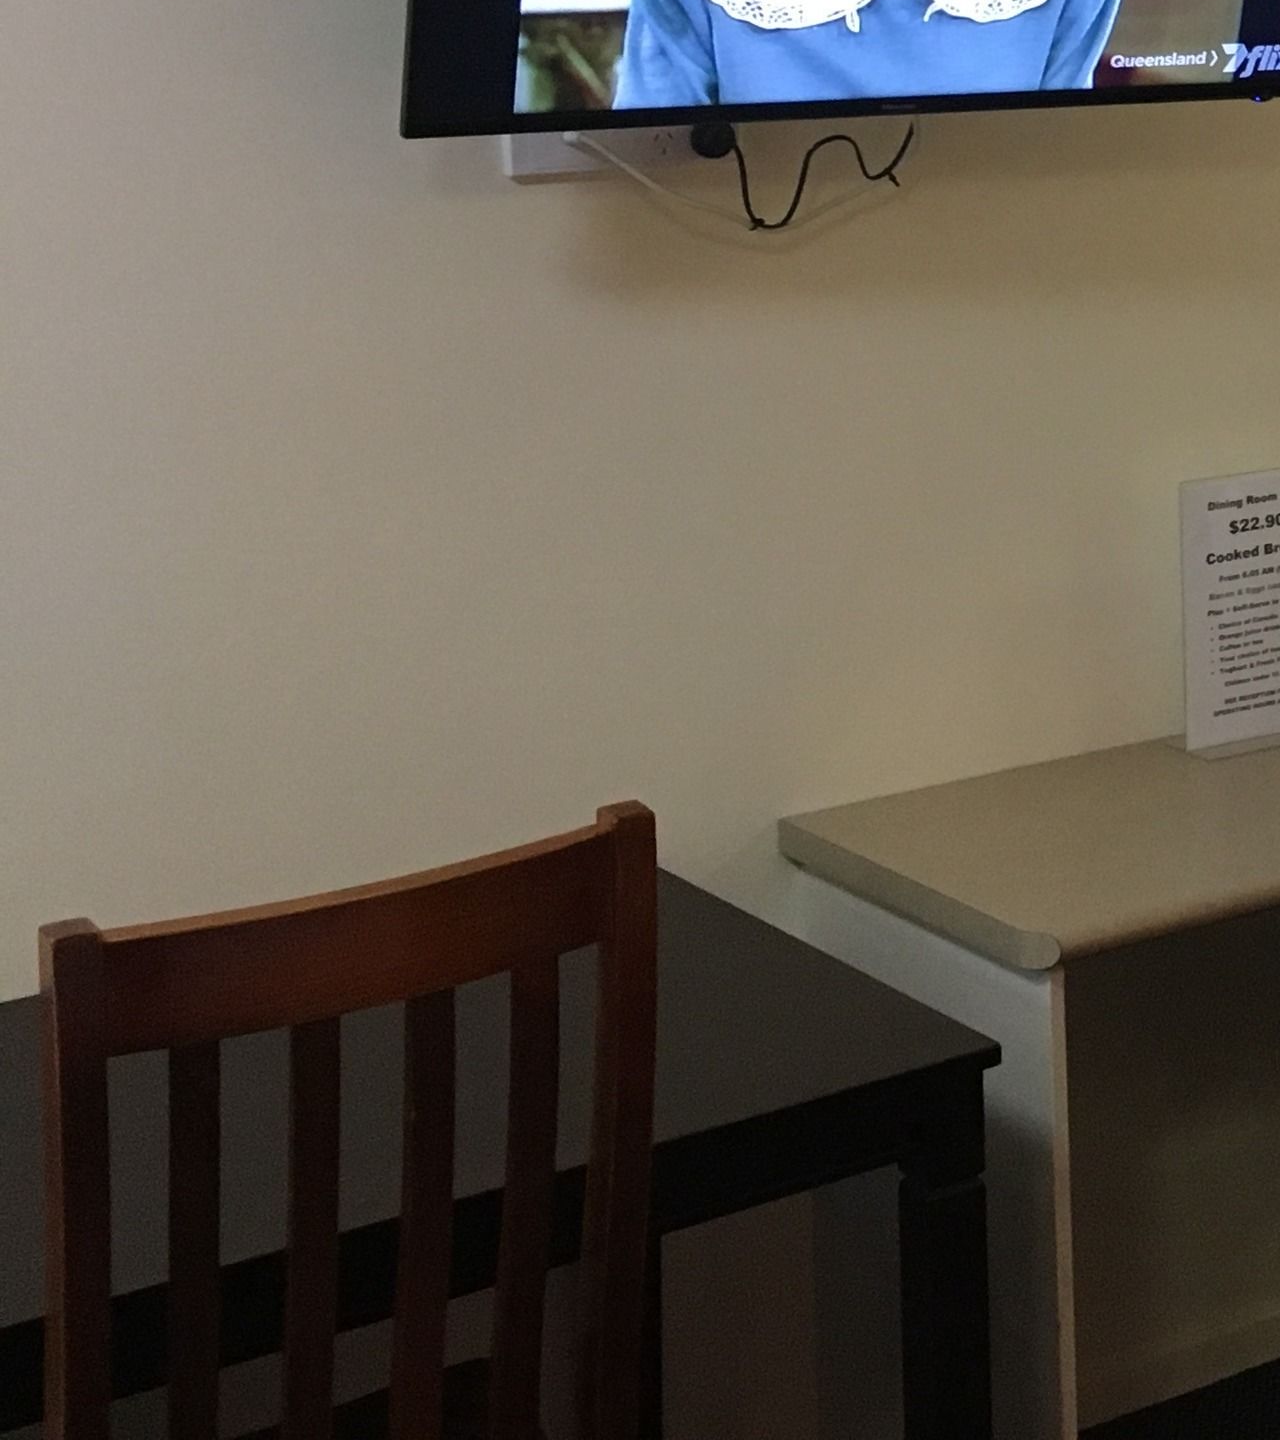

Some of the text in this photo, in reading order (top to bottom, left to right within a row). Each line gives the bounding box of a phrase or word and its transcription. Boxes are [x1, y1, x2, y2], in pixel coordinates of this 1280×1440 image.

[1110, 50, 1207, 69] Queensland
[1208, 499, 1243, 510] Dining
[1247, 493, 1277, 504] Room
[1206, 546, 1260, 564] Cooked
